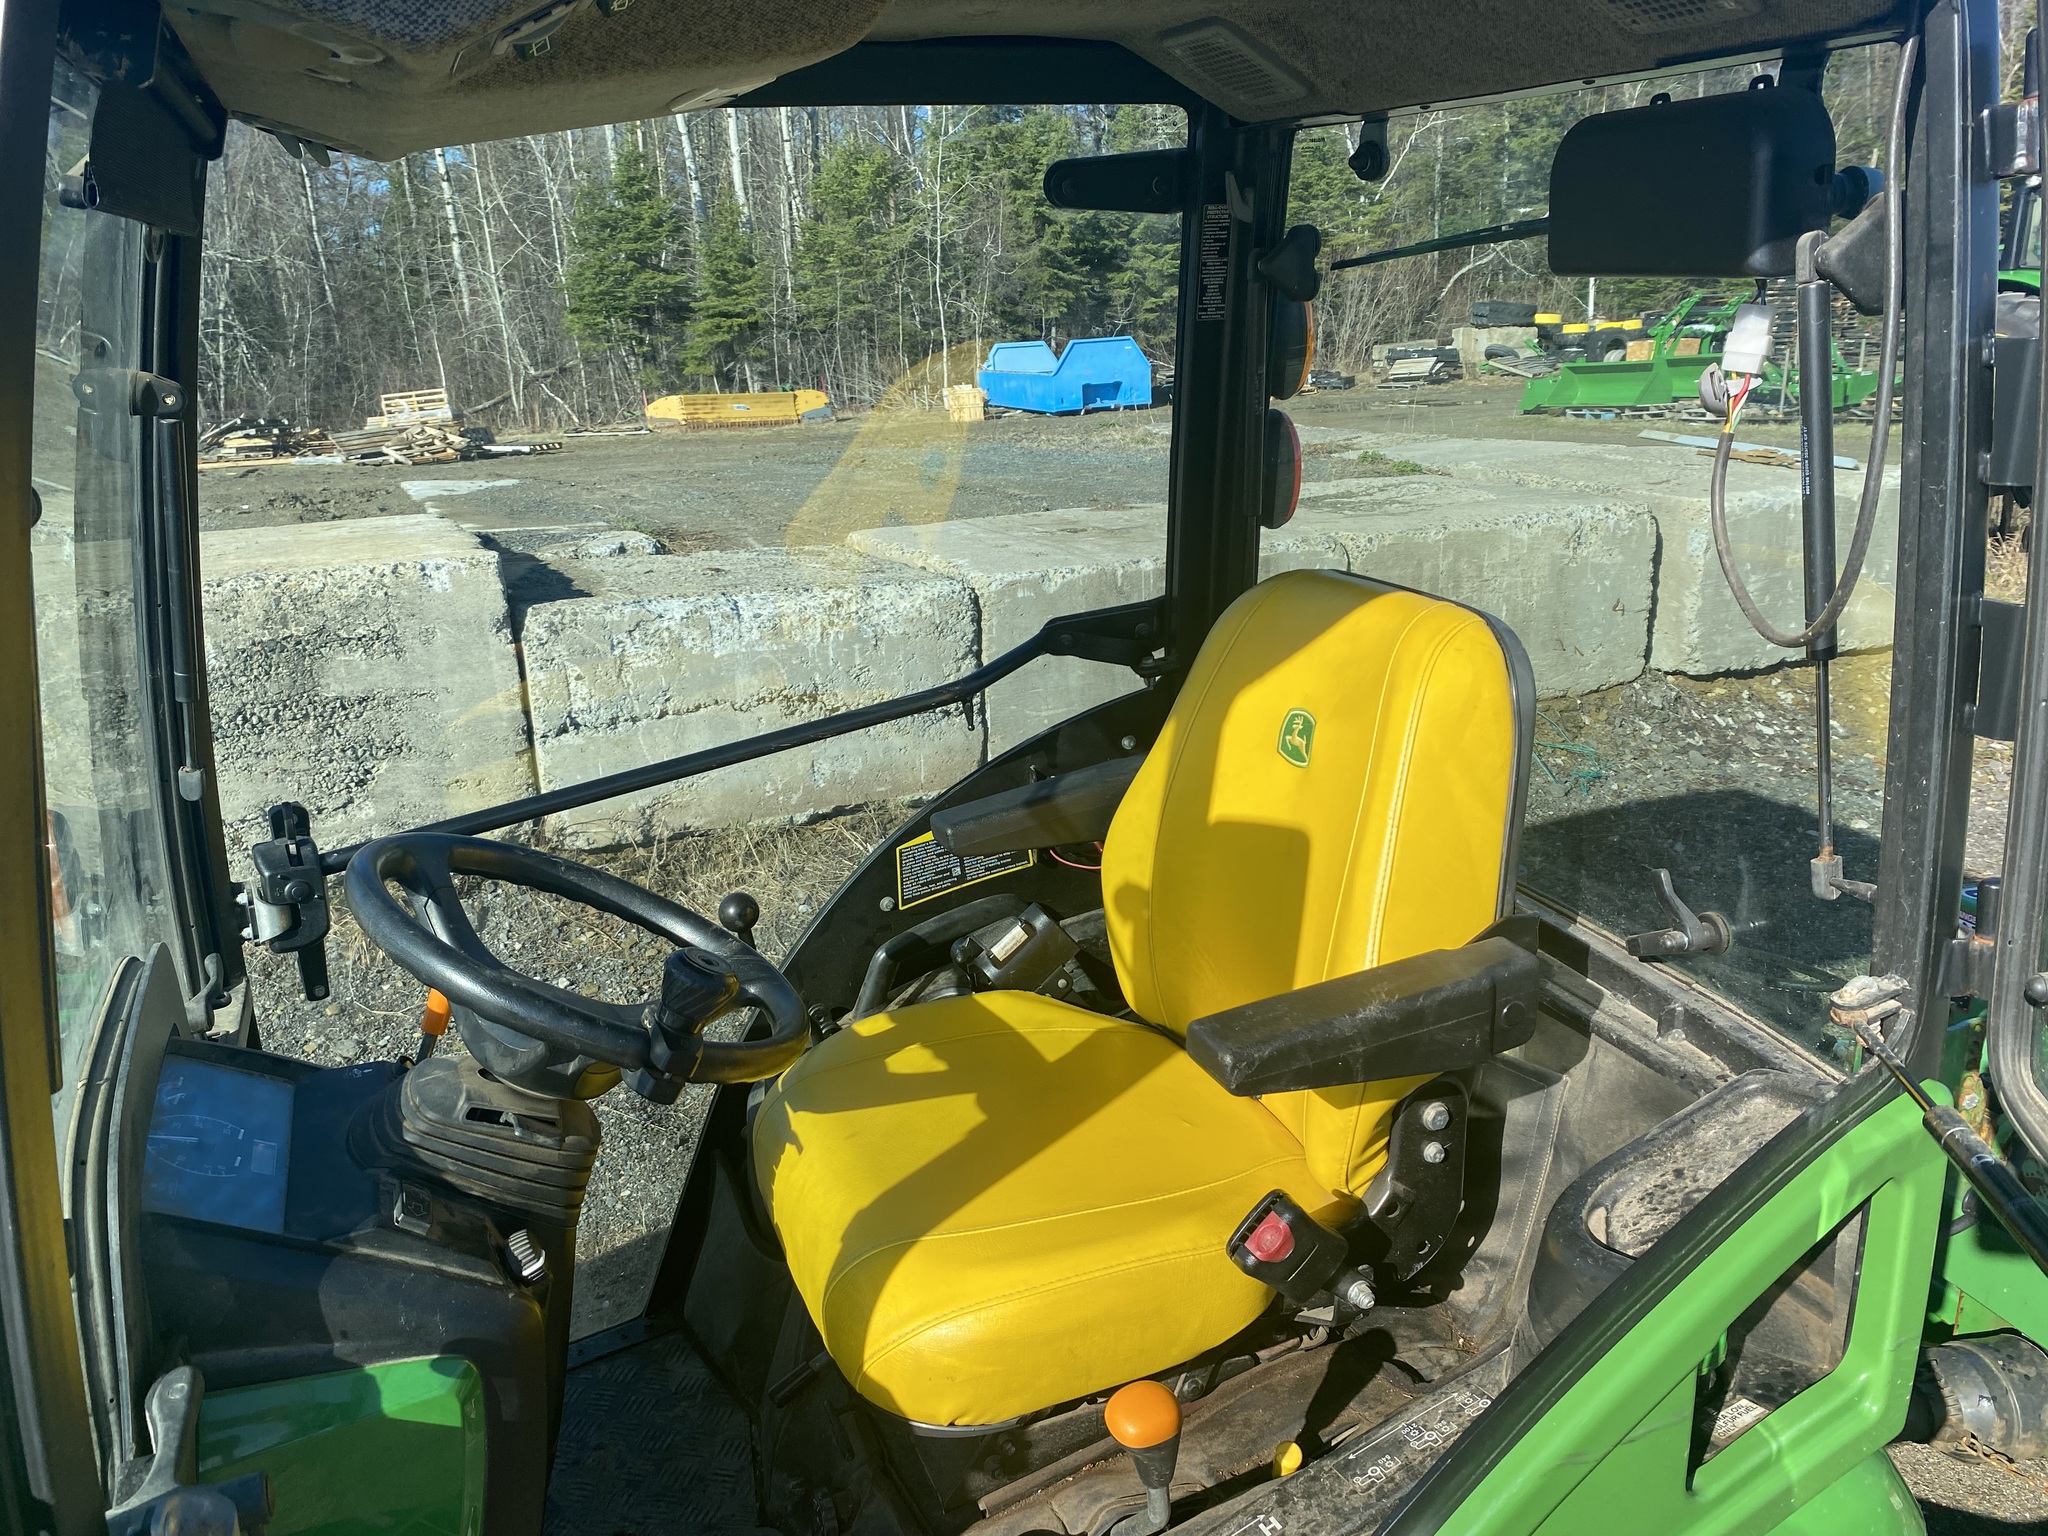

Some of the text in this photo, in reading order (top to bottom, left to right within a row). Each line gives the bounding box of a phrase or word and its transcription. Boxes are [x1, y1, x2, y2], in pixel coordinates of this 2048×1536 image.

[1726, 1403, 1745, 1416] LOW
[1738, 1405, 1759, 1418] FUEL
[1401, 1422, 1418, 1435] 2100
[1718, 1424, 1737, 1437] ONLY
[1258, 1516, 1282, 1536] H
